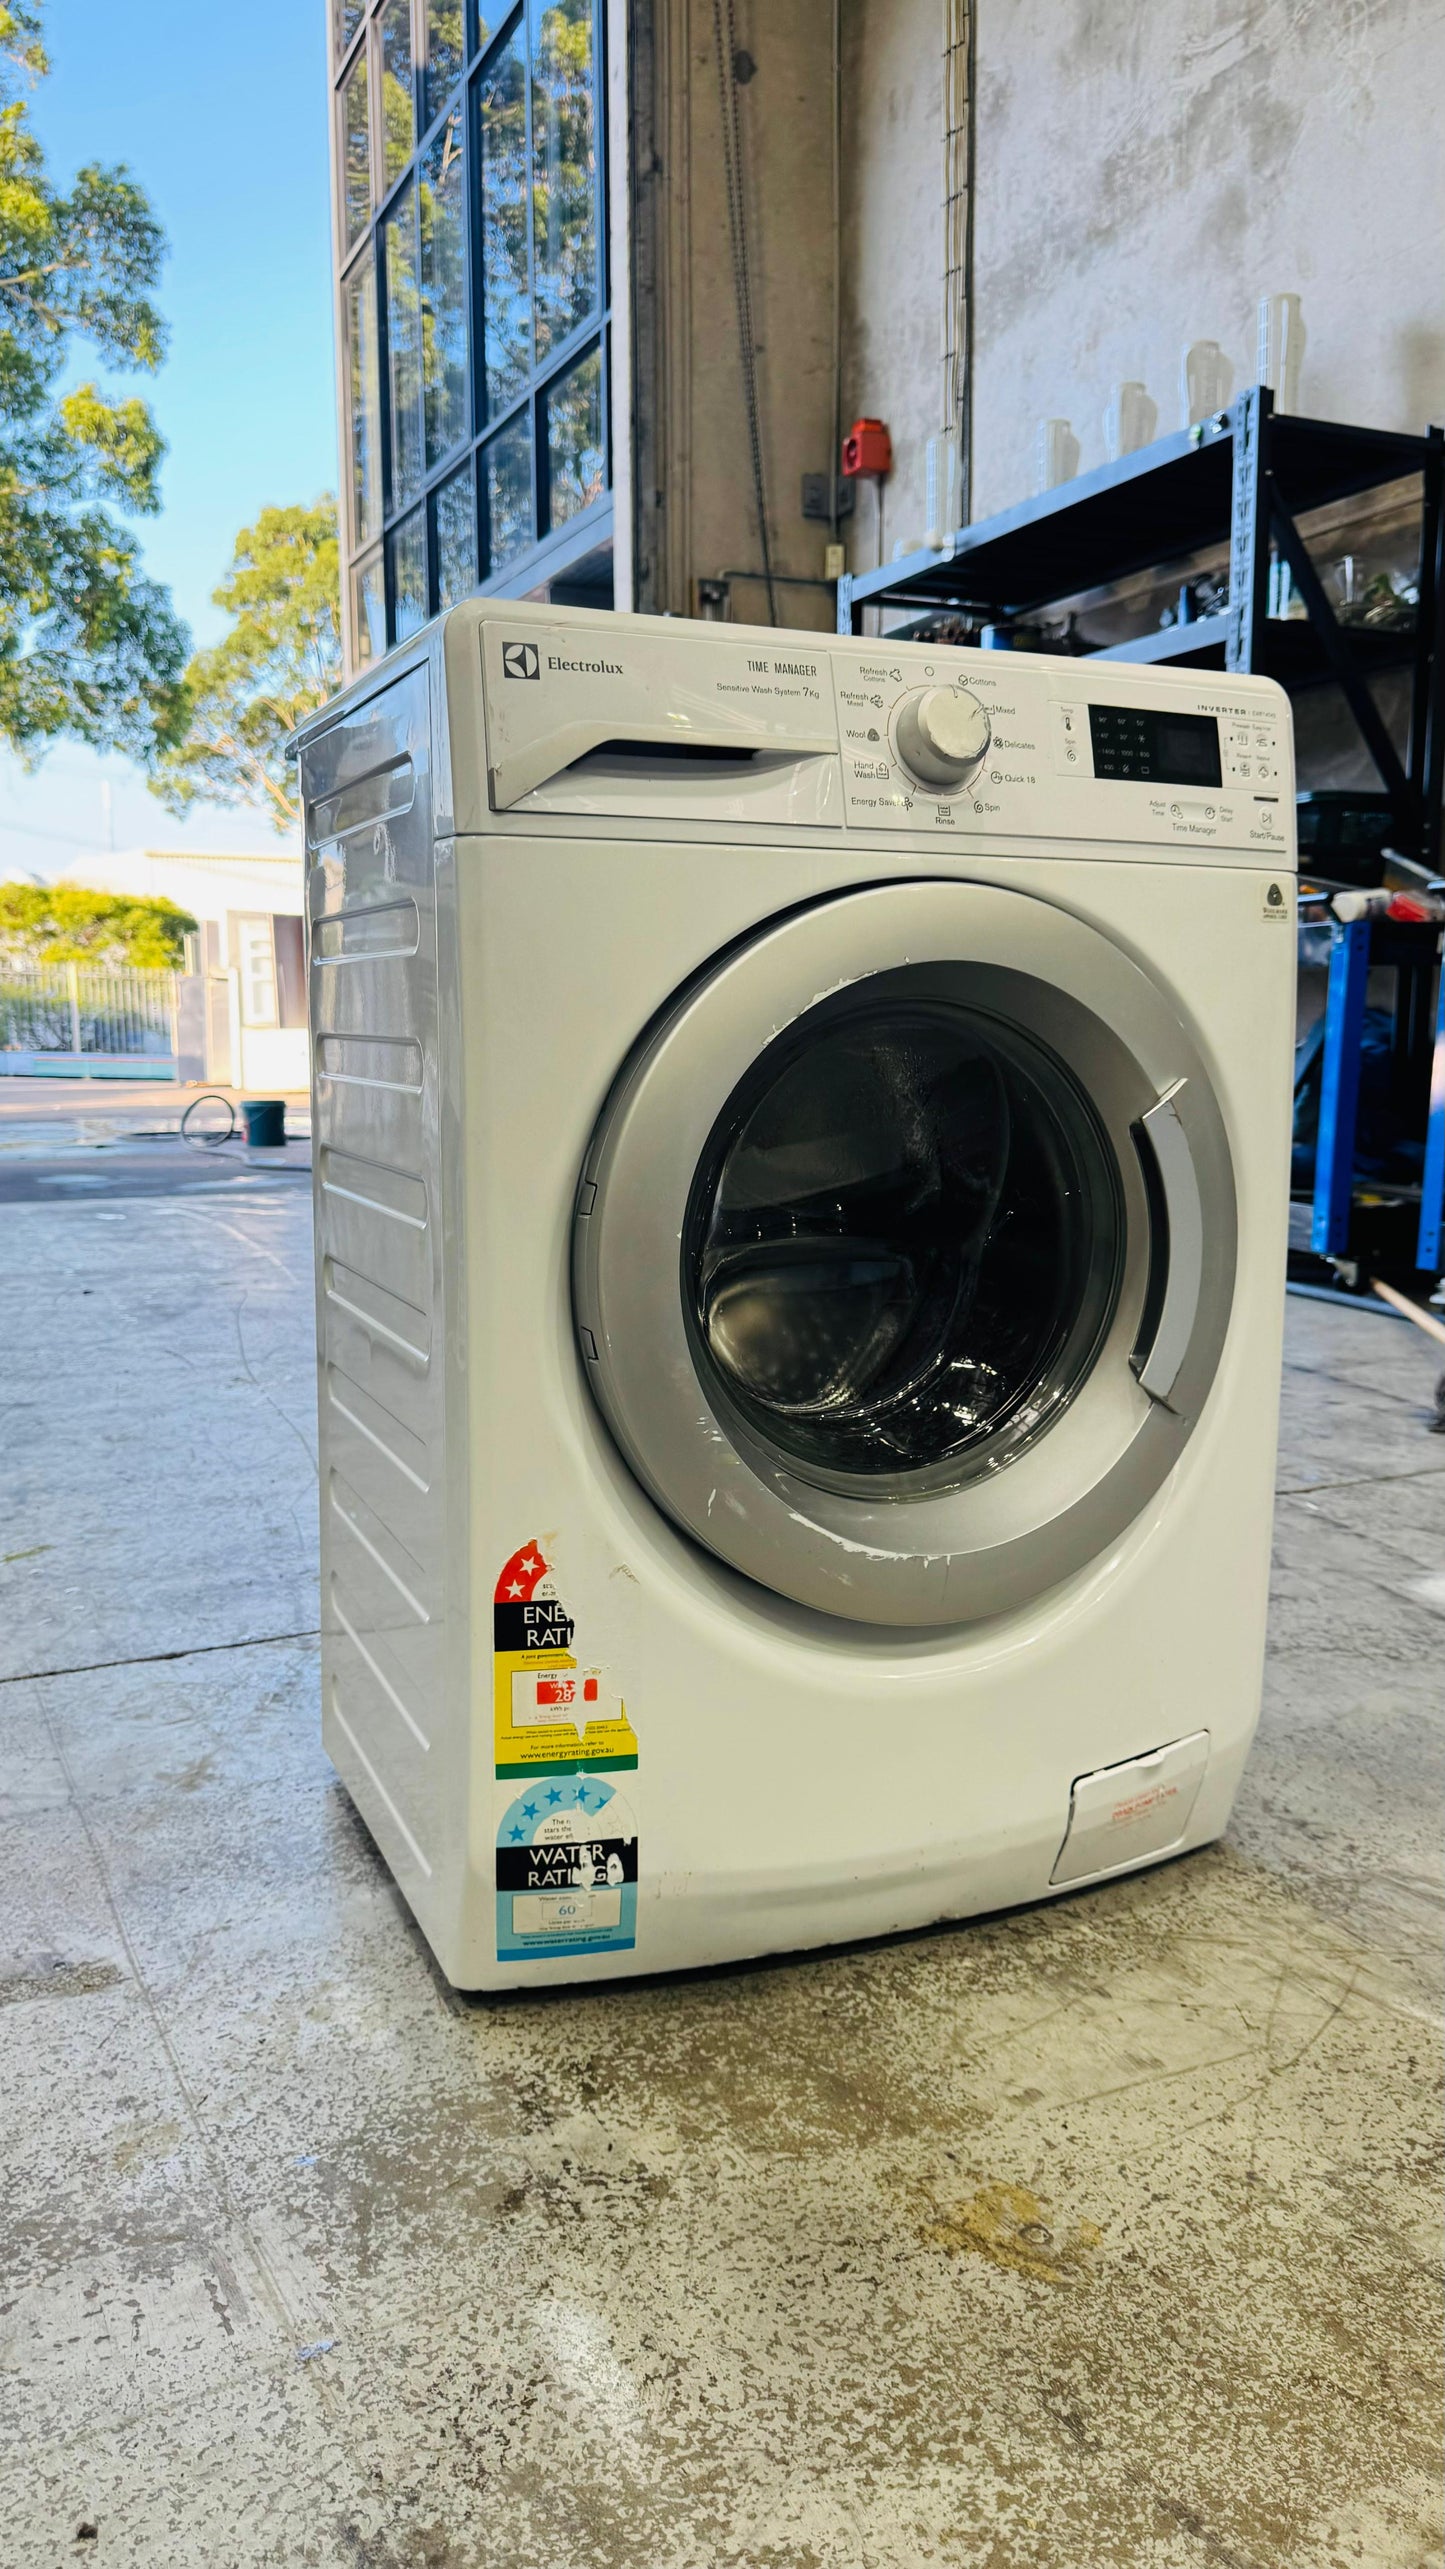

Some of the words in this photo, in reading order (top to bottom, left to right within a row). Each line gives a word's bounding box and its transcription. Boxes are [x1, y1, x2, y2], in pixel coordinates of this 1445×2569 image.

[548, 656, 623, 674] Electrolux
[747, 660, 769, 673] TIME
[775, 662, 816, 676] MANAGER
[860, 666, 887, 676] Refresh
[969, 677, 996, 686] Cottons
[717, 683, 749, 692] Sensitive
[752, 685, 772, 694] Wash
[775, 687, 800, 697] System
[840, 691, 868, 700] Refresh
[996, 706, 1015, 714] Mixed
[1197, 705, 1246, 715] INVERTER
[846, 730, 866, 738] Wool
[1004, 741, 1035, 750] Delicates
[854, 762, 874, 770] Hand
[854, 771, 875, 779] Wash
[1005, 775, 1024, 783] Quick
[1027, 776, 1035, 784] 18
[851, 797, 876, 807] Energy
[879, 798, 901, 806] Sav
[985, 804, 1000, 812] Spin
[936, 817, 955, 825] Rinse
[1172, 823, 1187, 832] Time
[1189, 824, 1216, 835] Manager
[1250, 830, 1284, 841] Start/Pause
[520, 1747, 614, 1759] www.energyrating.gov.au
[528, 1865, 606, 1887] RATIG
[559, 1905, 576, 1916] 60
